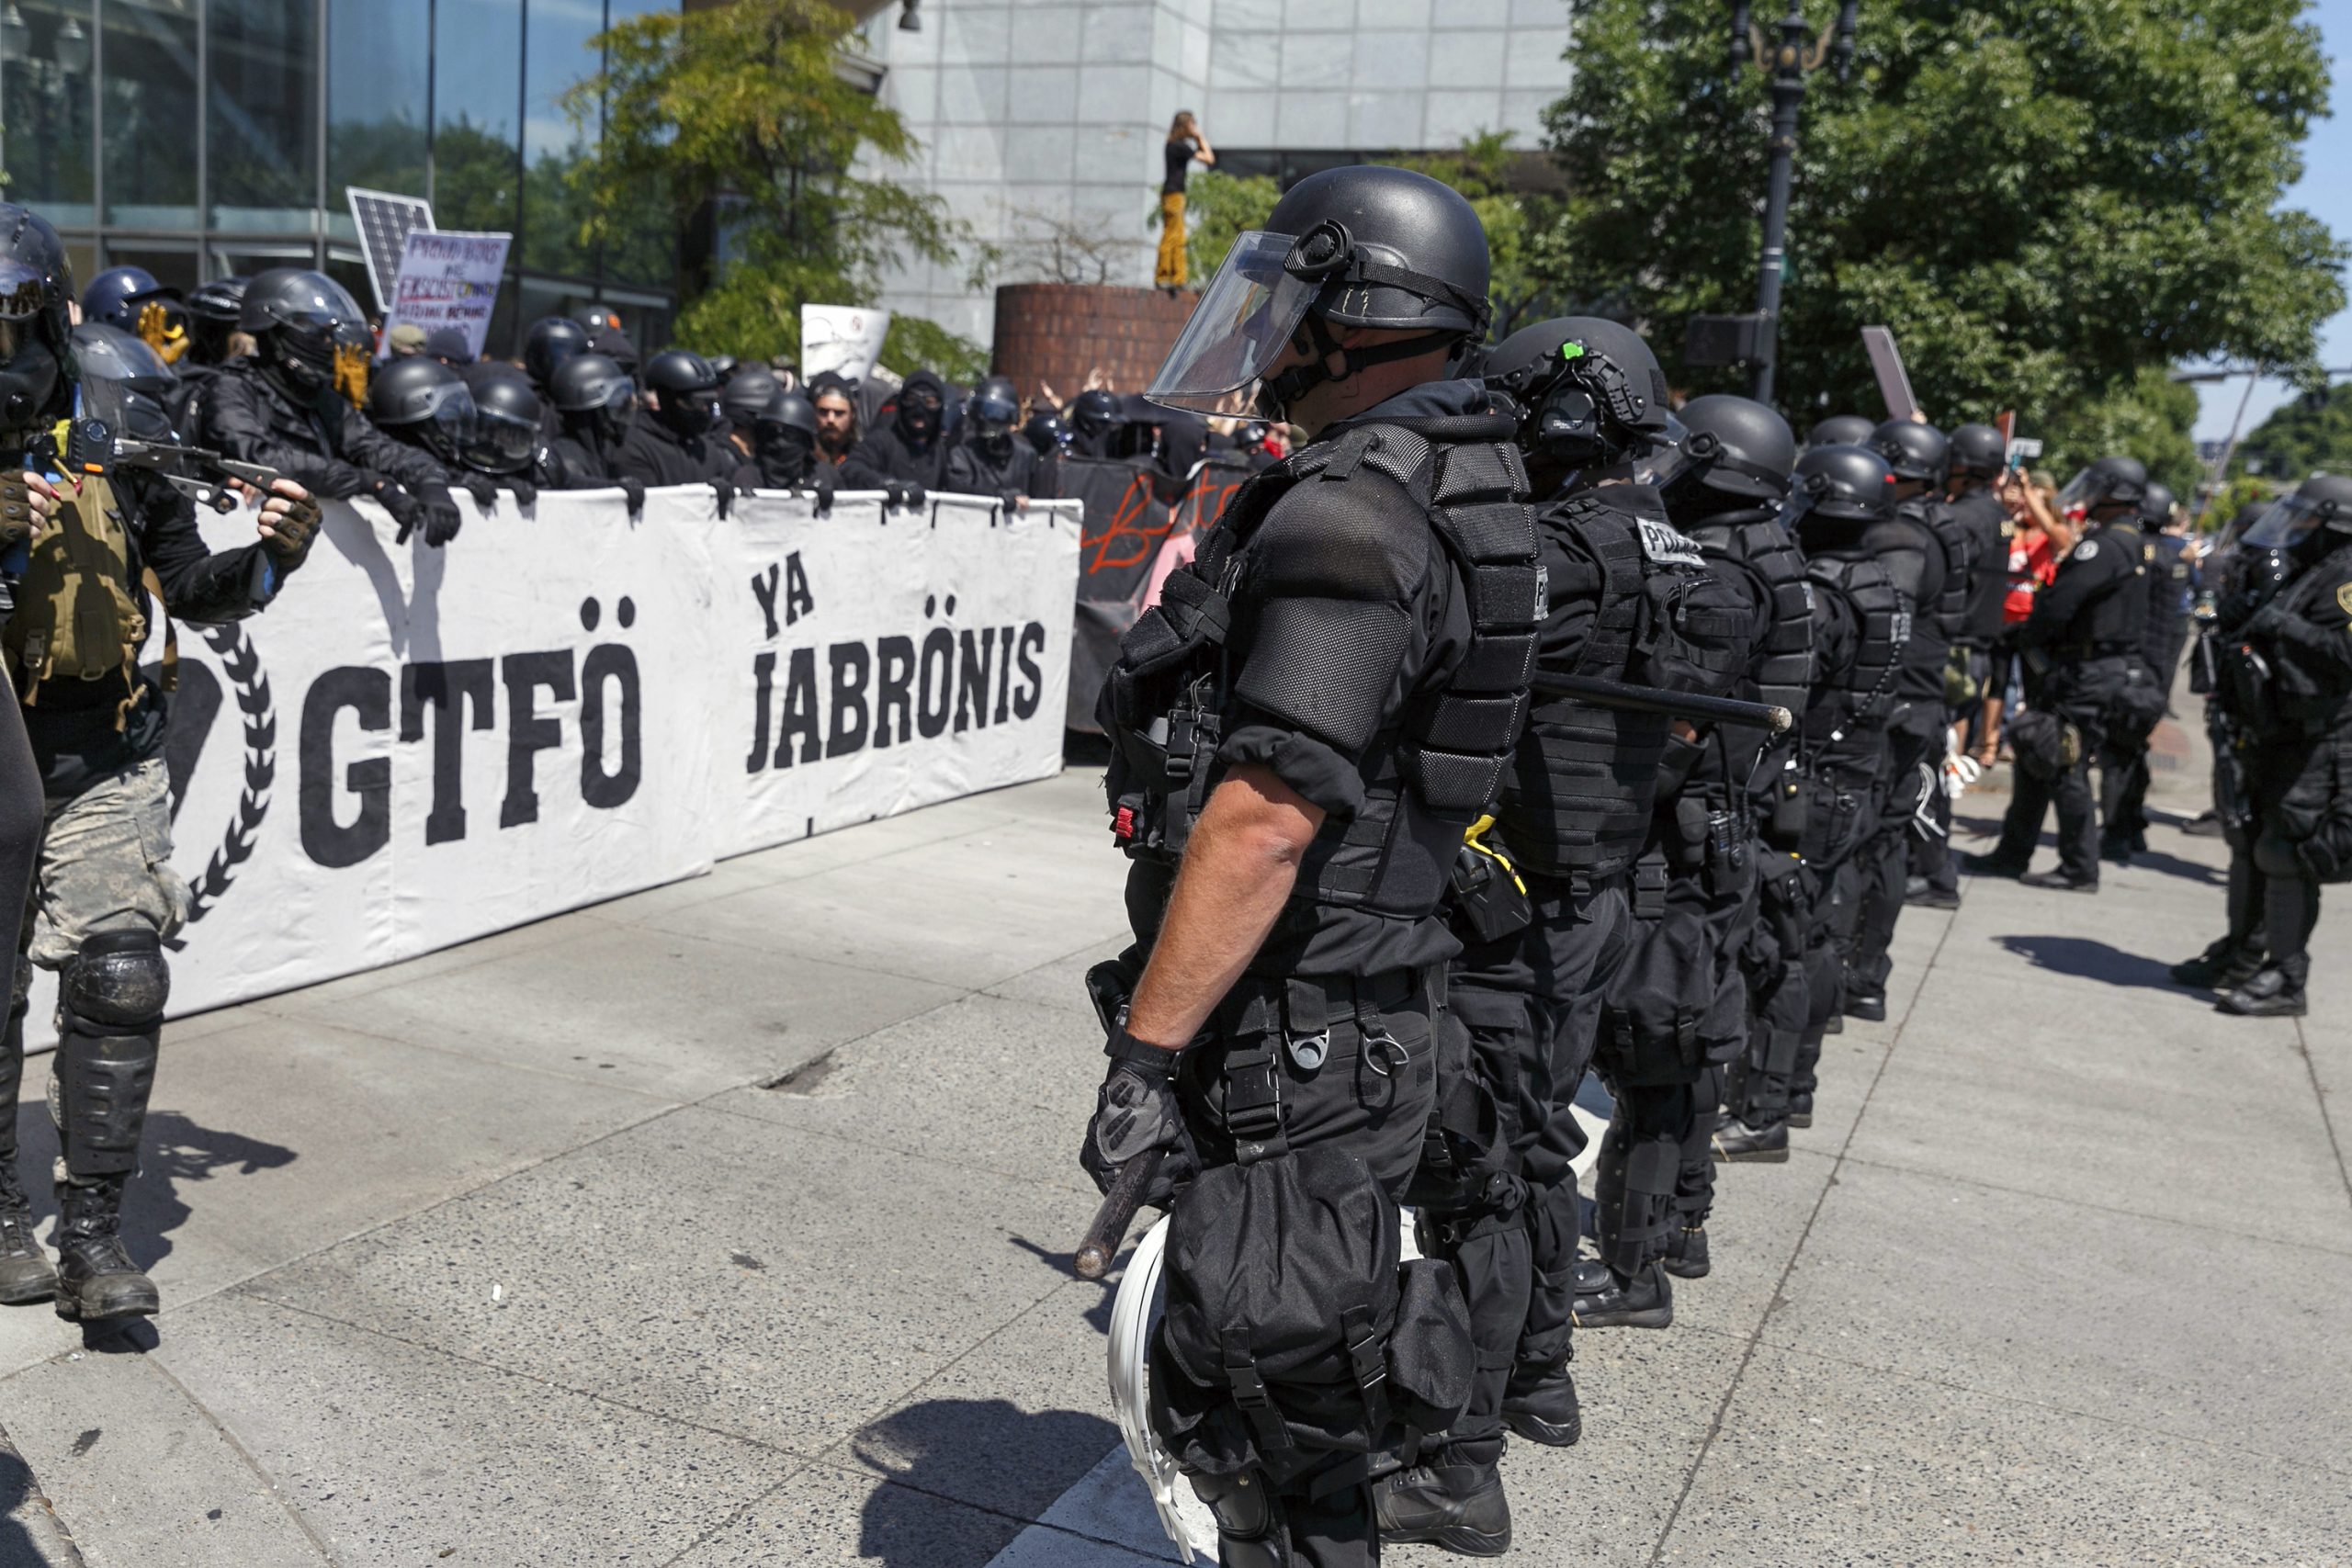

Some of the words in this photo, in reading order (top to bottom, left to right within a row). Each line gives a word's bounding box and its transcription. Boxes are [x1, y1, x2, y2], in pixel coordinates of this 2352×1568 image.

[747, 594, 1046, 775] JABRÖNIS
[751, 550, 814, 640] YA
[299, 595, 641, 868] GTFÖ
